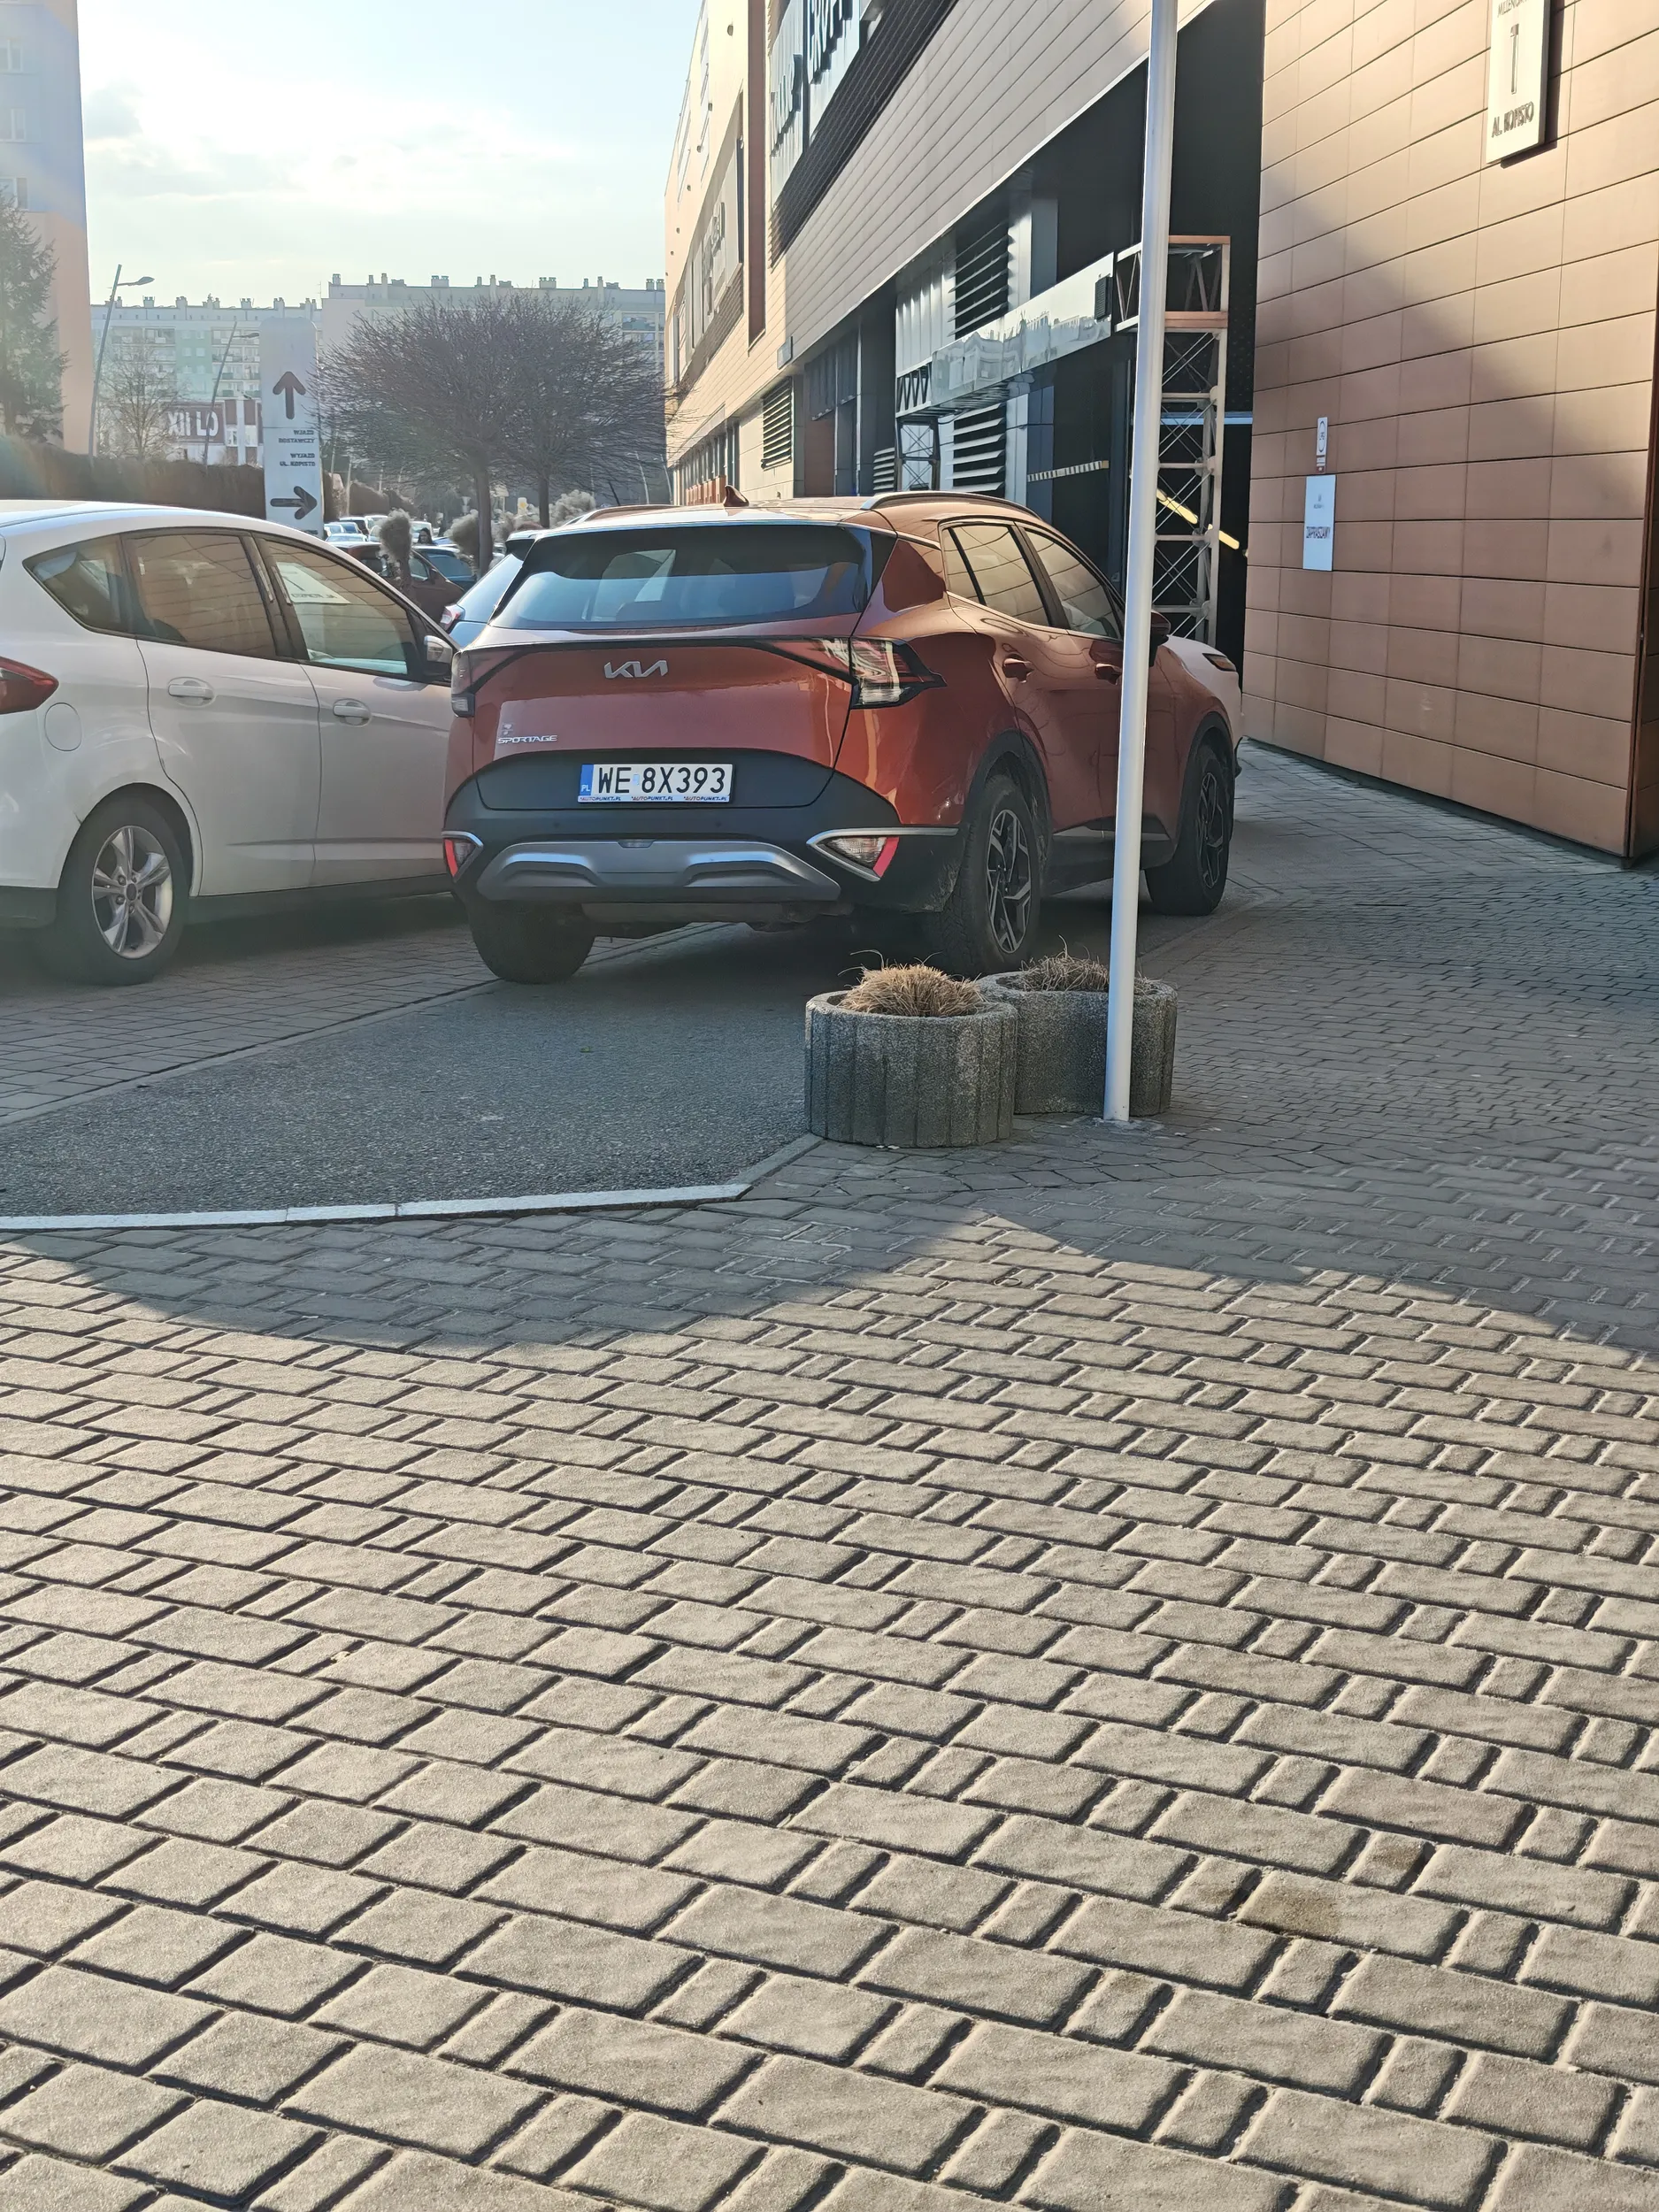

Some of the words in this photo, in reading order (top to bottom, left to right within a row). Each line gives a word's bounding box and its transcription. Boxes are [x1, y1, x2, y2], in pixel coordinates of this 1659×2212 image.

[604, 660, 668, 679] KIA
[497, 734, 557, 744] SPORTAGE
[598, 767, 632, 794] WE
[641, 767, 726, 794] 8X393
